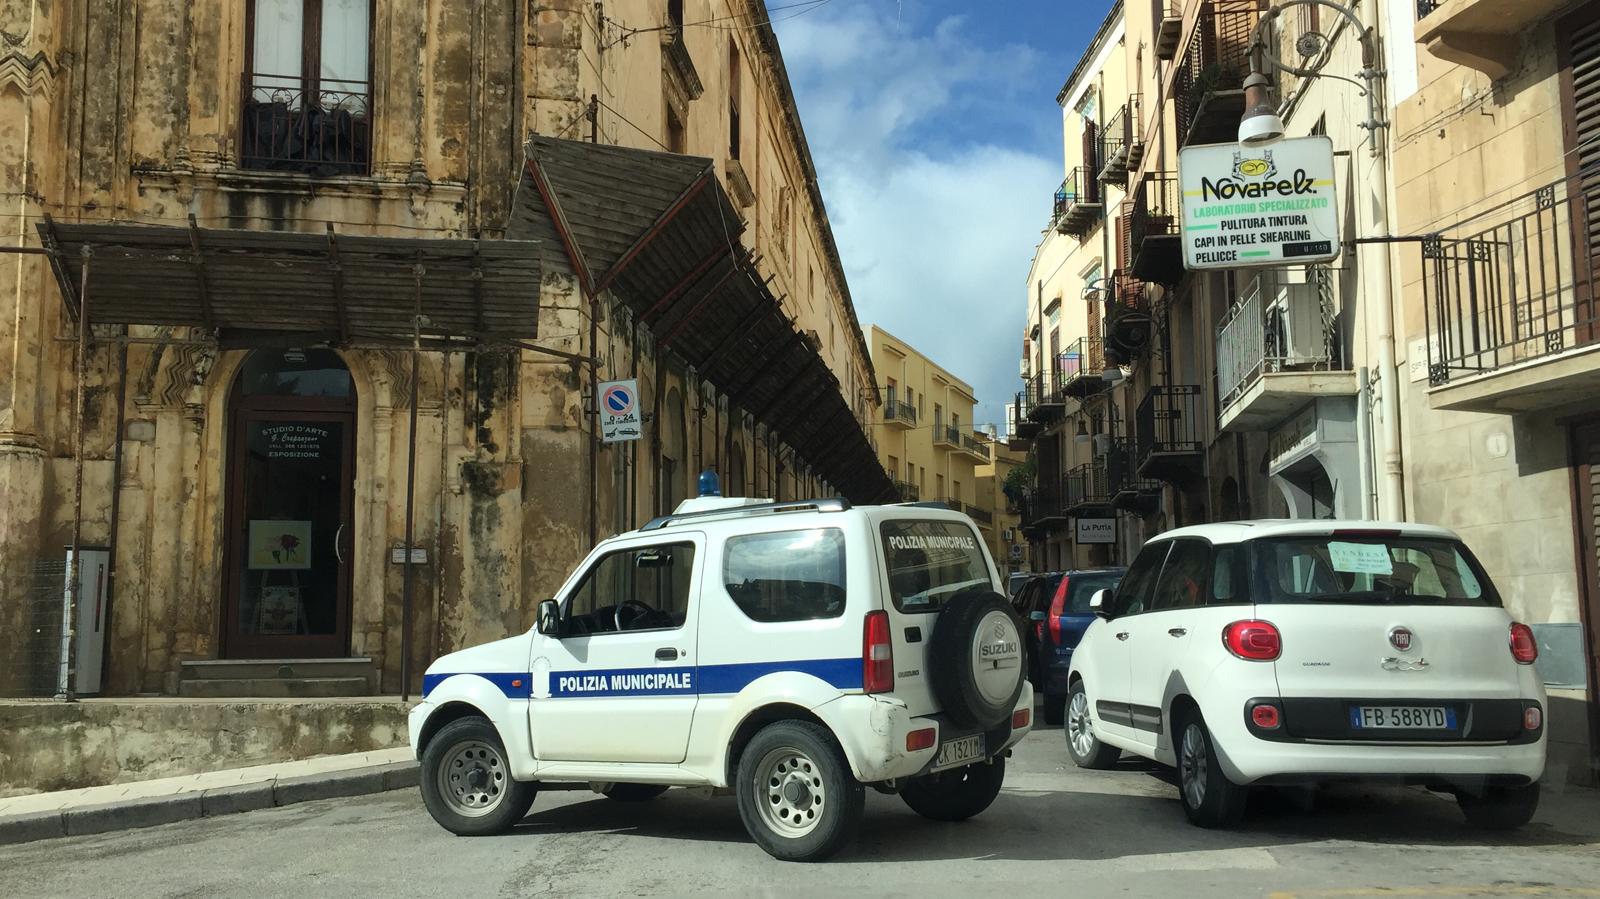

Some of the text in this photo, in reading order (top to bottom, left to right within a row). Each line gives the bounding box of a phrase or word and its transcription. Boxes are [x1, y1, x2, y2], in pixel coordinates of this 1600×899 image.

[1193, 197, 1329, 218] LABORATORIO SPECIALIZZATO
[1220, 214, 1308, 231] PULITURA TINTURA
[1194, 230, 1311, 248] CAPI IN PELLE SHEARLING
[1195, 250, 1238, 264] PELLICCE
[623, 413, 634, 421] 24
[261, 426, 329, 438] STUDIO D'ARTE
[889, 535, 974, 549] POLIZIA MUNICIPALE
[1395, 633, 1409, 645] FIAT
[981, 642, 1017, 656] SUZUKI
[559, 673, 691, 692] POLIZIA MUNICIPALE
[1363, 708, 1384, 726] FB
[1391, 708, 1444, 727] 588YD
[953, 736, 979, 760] 132YM
